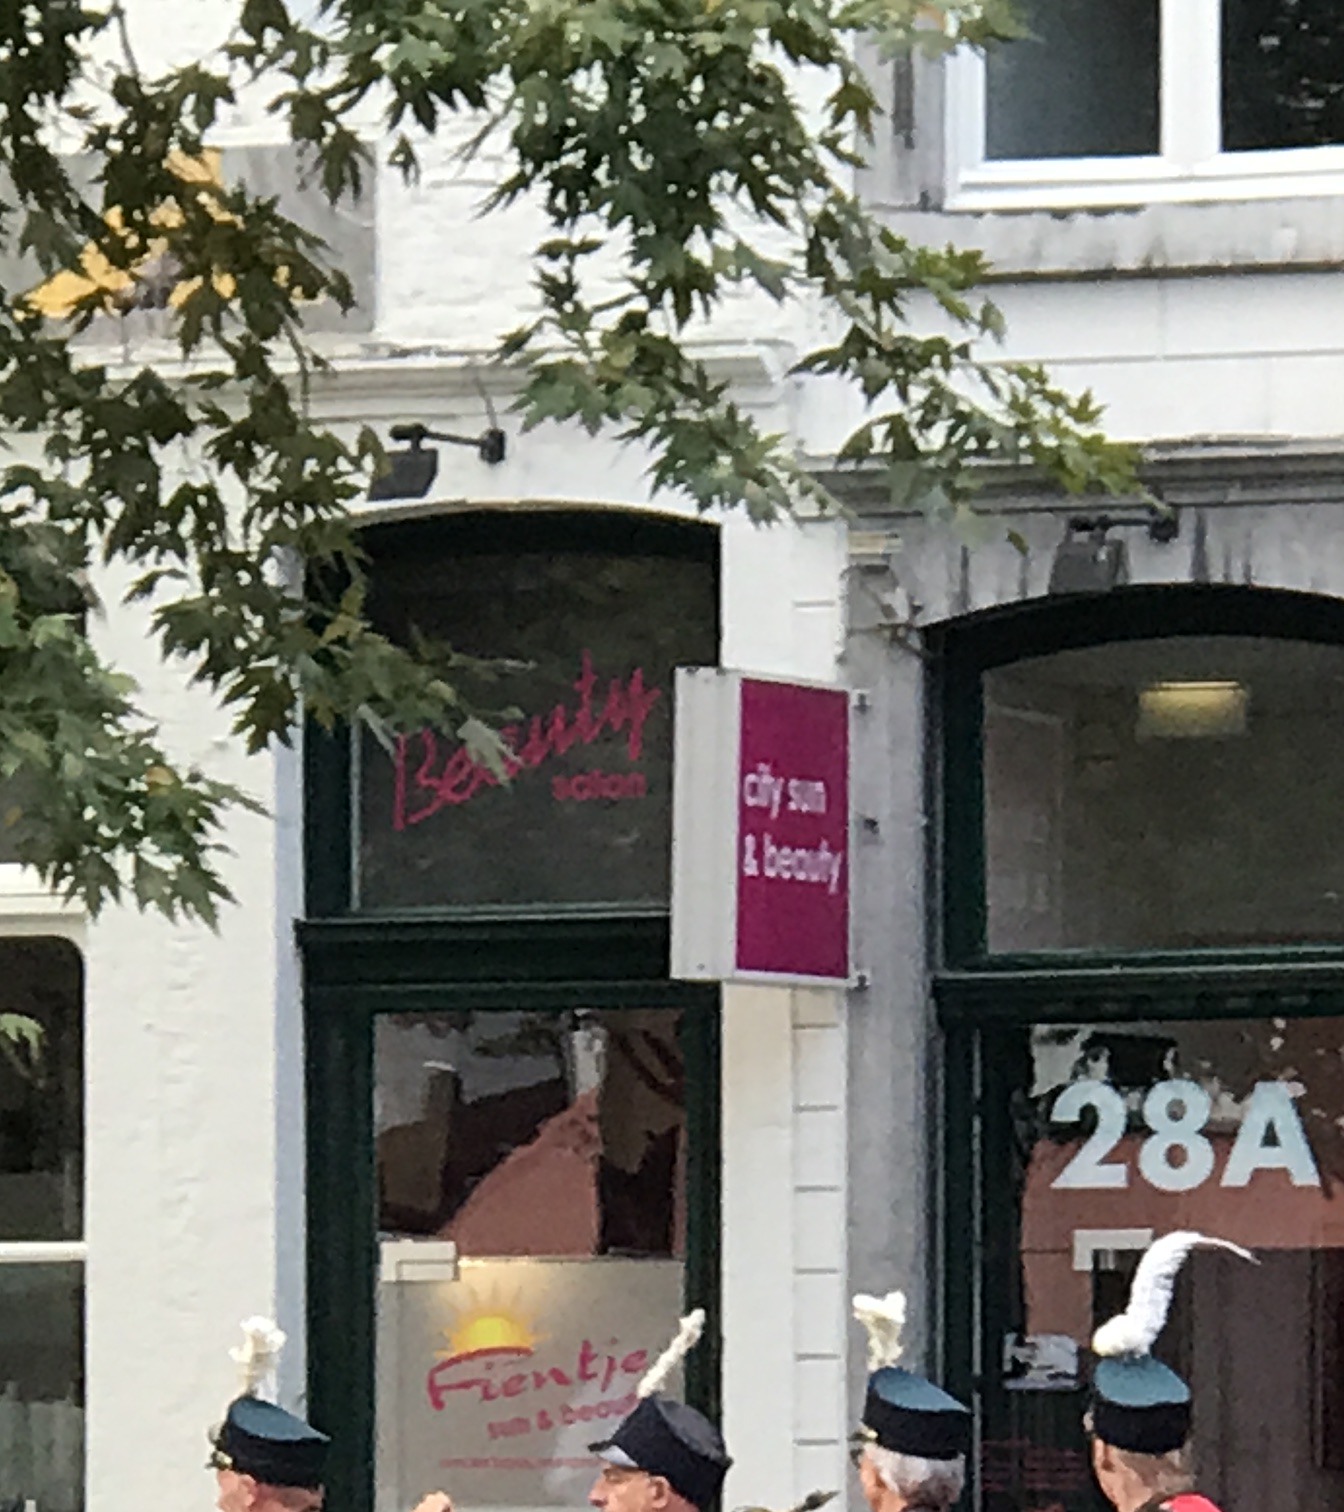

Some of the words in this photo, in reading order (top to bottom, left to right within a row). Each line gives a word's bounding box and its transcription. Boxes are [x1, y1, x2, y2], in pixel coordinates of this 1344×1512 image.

[743, 762, 785, 819] city
[787, 778, 827, 814] sun
[742, 832, 760, 877] &
[763, 832, 843, 894] beauty
[1050, 1078, 1322, 1191] 28A
[427, 1336, 648, 1410] Fientje
[536, 1408, 554, 1431] &
